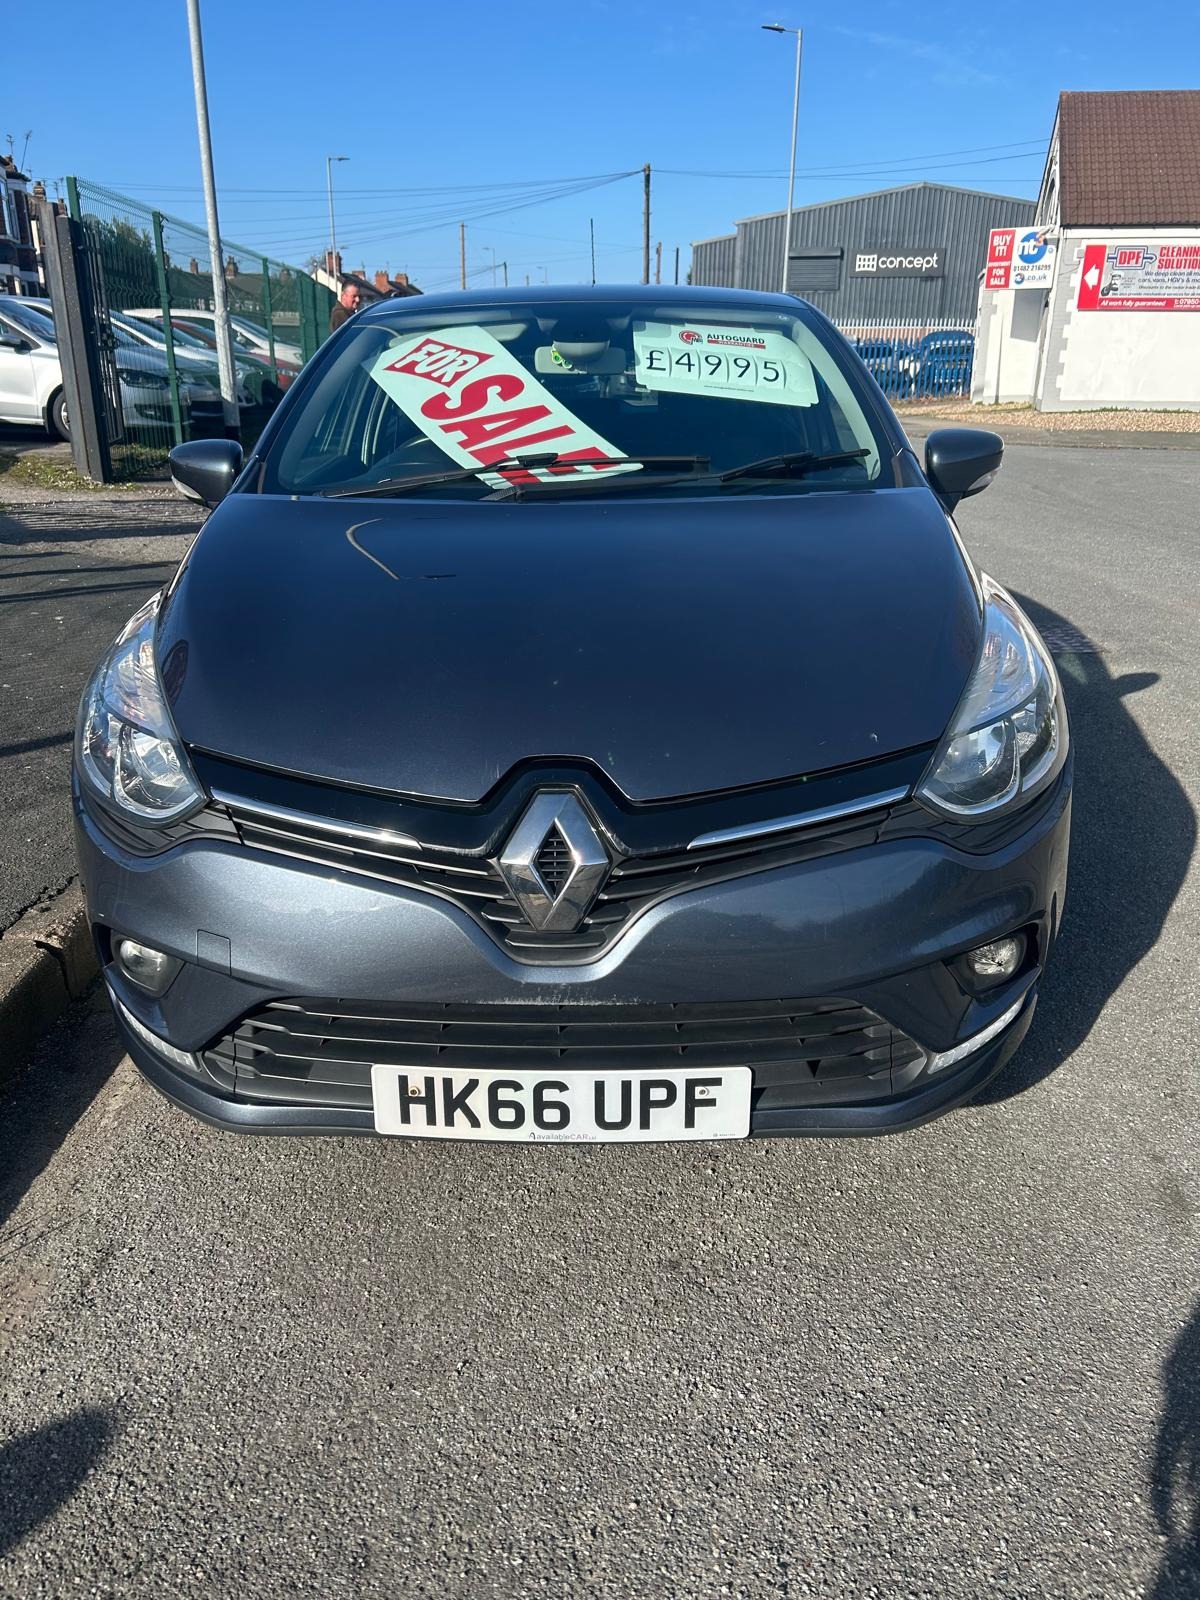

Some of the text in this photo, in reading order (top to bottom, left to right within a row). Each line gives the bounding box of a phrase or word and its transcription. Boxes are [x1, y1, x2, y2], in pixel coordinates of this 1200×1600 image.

[993, 234, 1012, 246] BUY
[995, 246, 1007, 257] IT!
[1159, 246, 1200, 257] CLEANIN
[878, 252, 938, 272] concept
[1118, 251, 1142, 265] DPF
[1157, 258, 1200, 269] SOLUTIO
[992, 268, 1005, 276] FOR
[990, 277, 1005, 285] SALE
[1122, 300, 1134, 308] fully
[1134, 300, 1167, 308] guaranteed
[707, 333, 765, 345] AUTOGUARD
[395, 343, 479, 383] FOR
[646, 350, 780, 383] £4995
[397, 1074, 723, 1131] HK66 UPF
